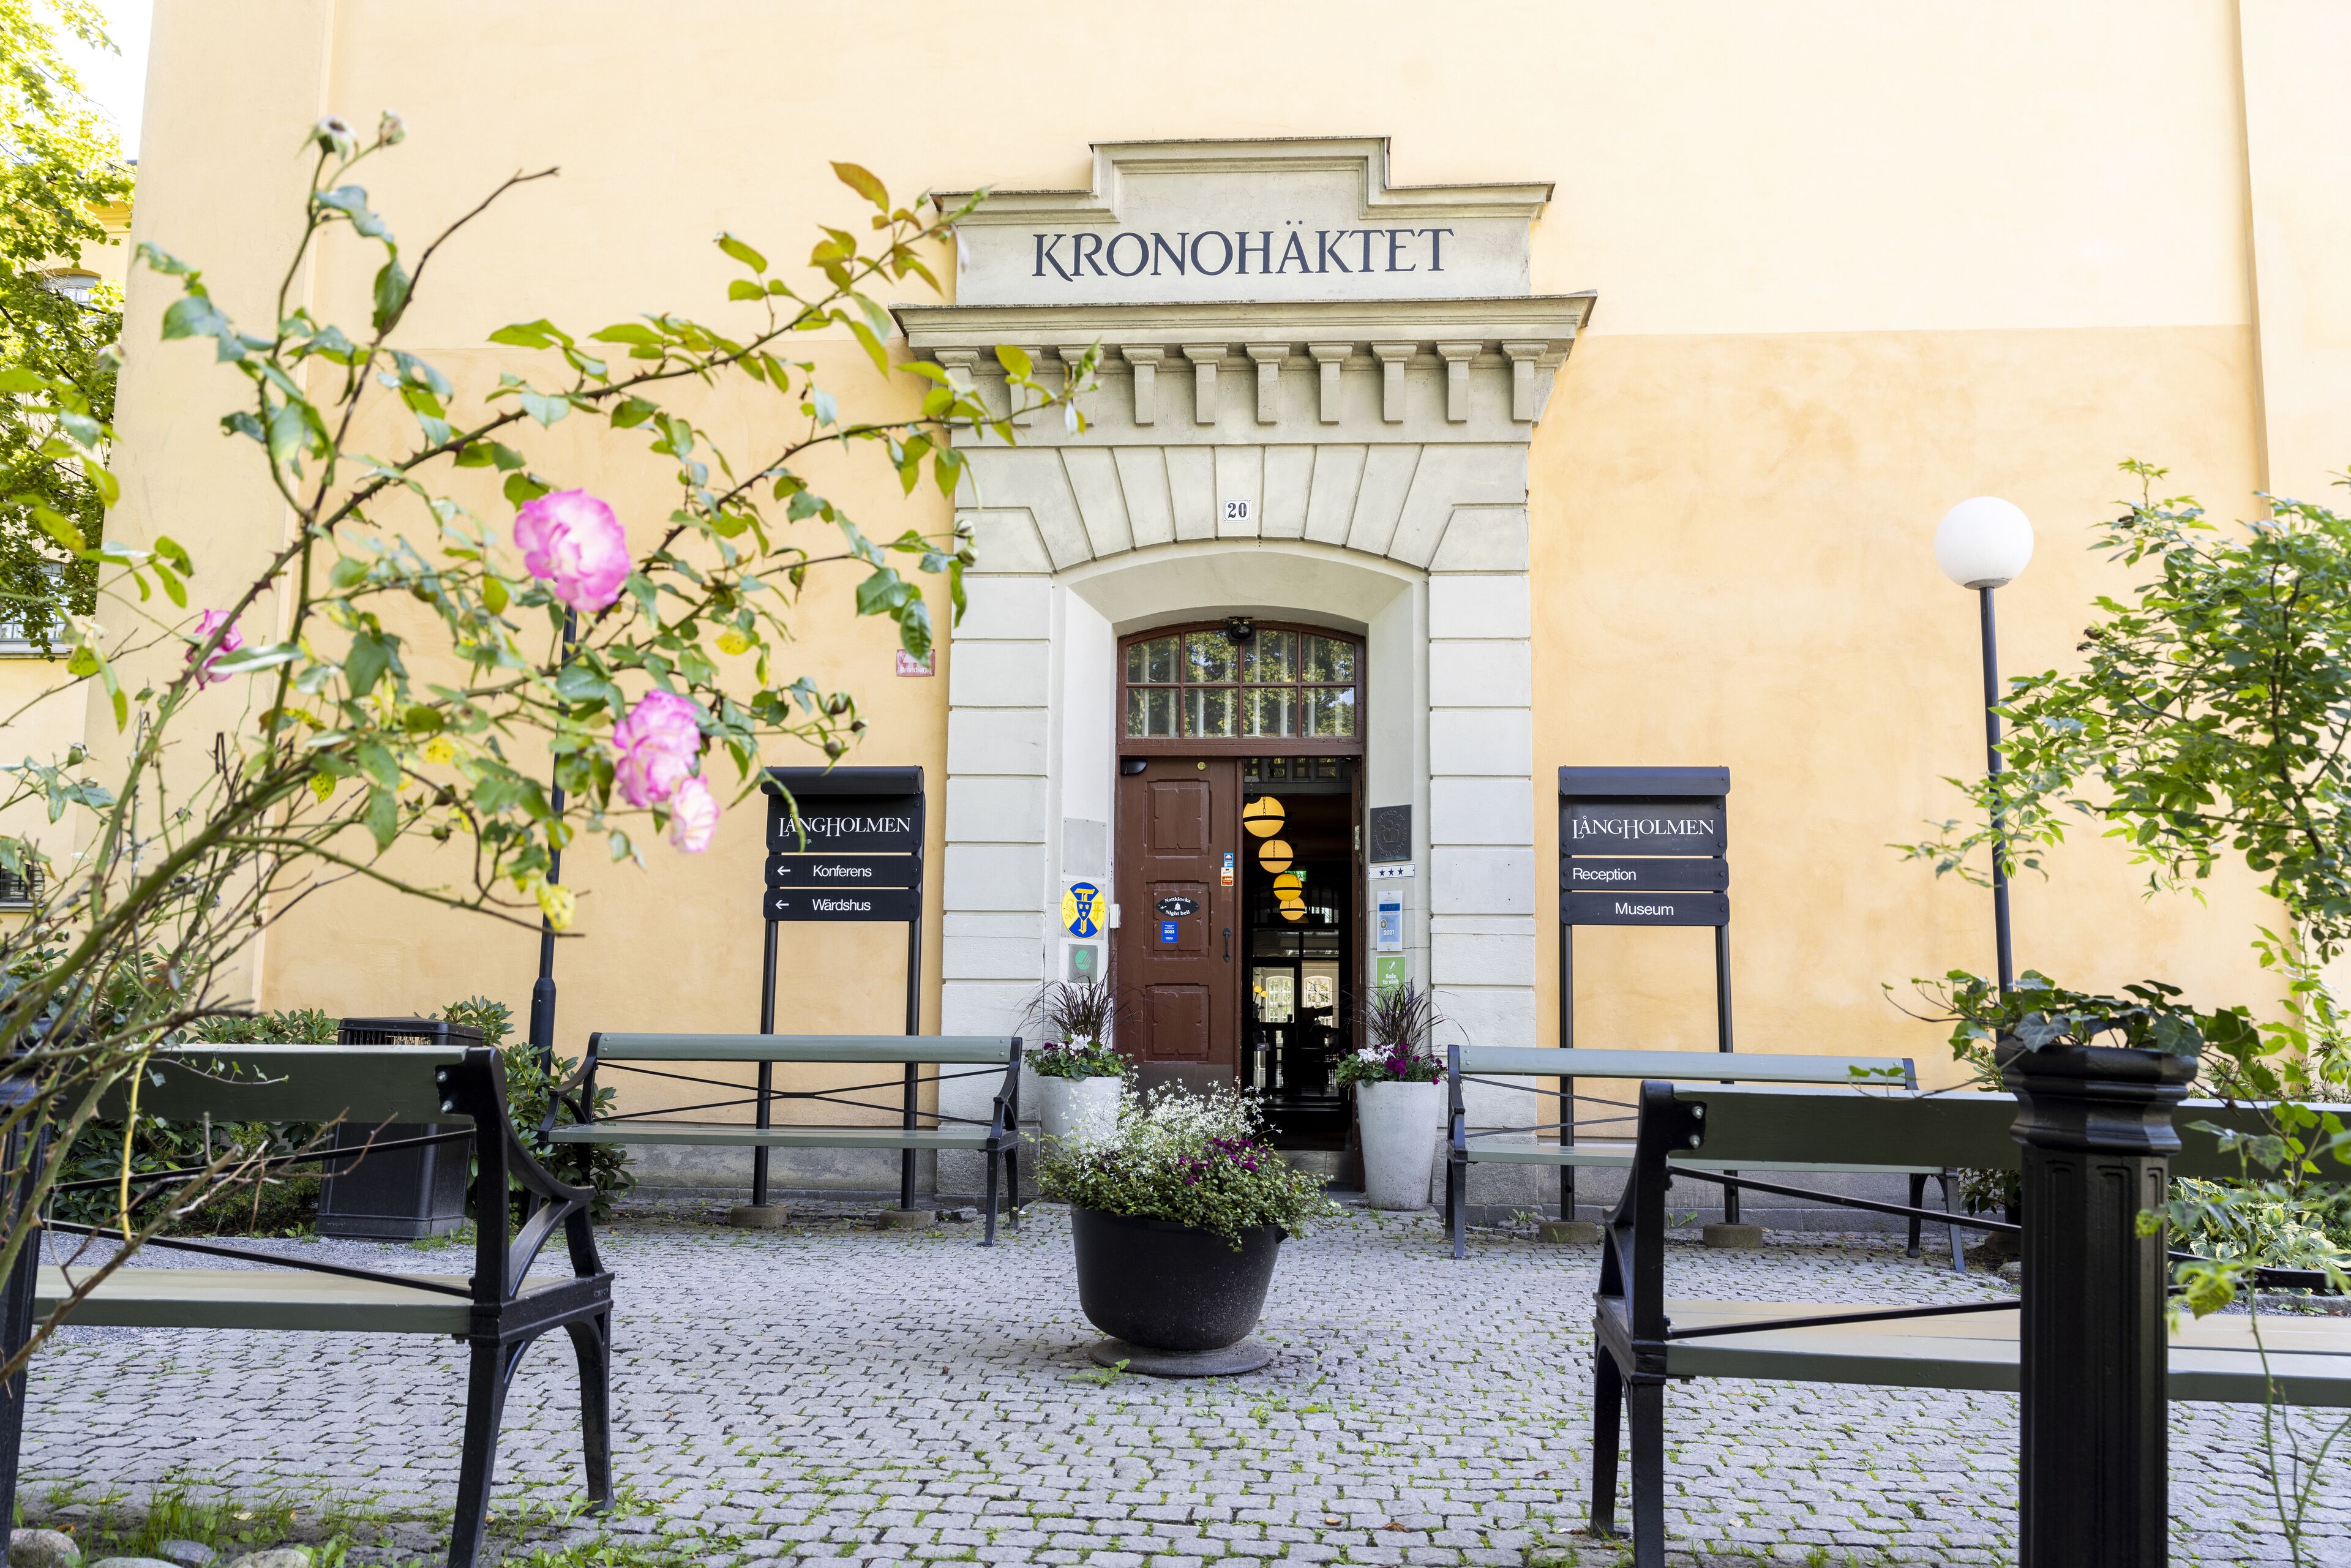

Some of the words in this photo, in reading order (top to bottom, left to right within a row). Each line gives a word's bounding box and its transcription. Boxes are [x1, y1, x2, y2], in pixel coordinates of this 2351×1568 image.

[1032, 220, 1454, 282] KRONOHÄKTET
[1228, 502, 1247, 518] 20
[778, 814, 911, 837] LÅNGHOLMEN
[1572, 815, 1714, 839] LÅNGHOLMEN
[813, 865, 872, 877] Konferens
[1573, 868, 1637, 882] Reception
[812, 898, 871, 911] Wärdshus
[1615, 902, 1674, 915] Museum
